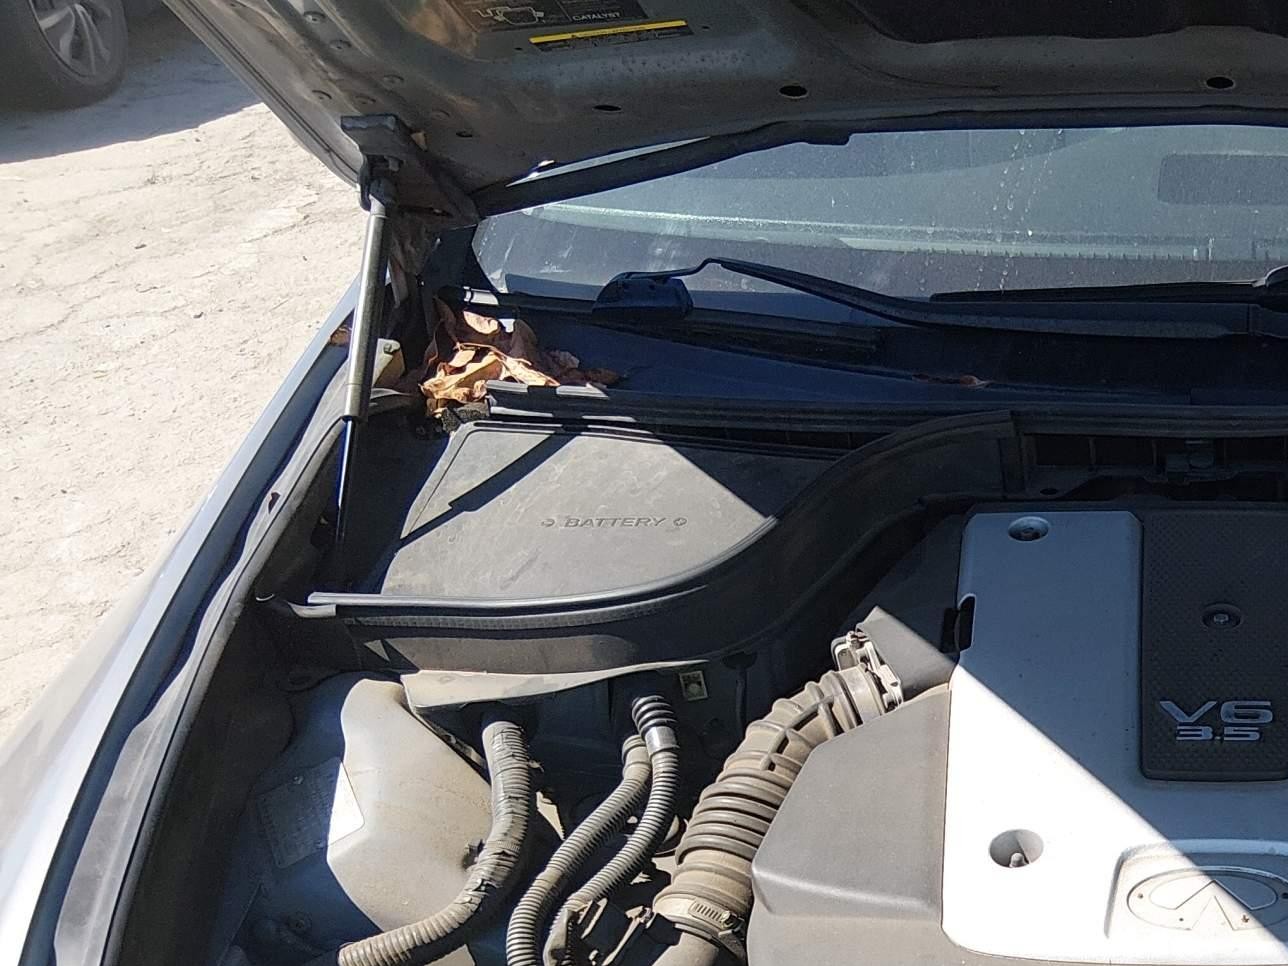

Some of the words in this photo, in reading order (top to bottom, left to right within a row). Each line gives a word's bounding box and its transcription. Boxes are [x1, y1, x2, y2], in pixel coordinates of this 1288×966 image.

[572, 11, 621, 22] CATALYST
[564, 517, 667, 528] BATTERY
[1160, 700, 1273, 724] V6
[1176, 725, 1260, 741] 3.5
